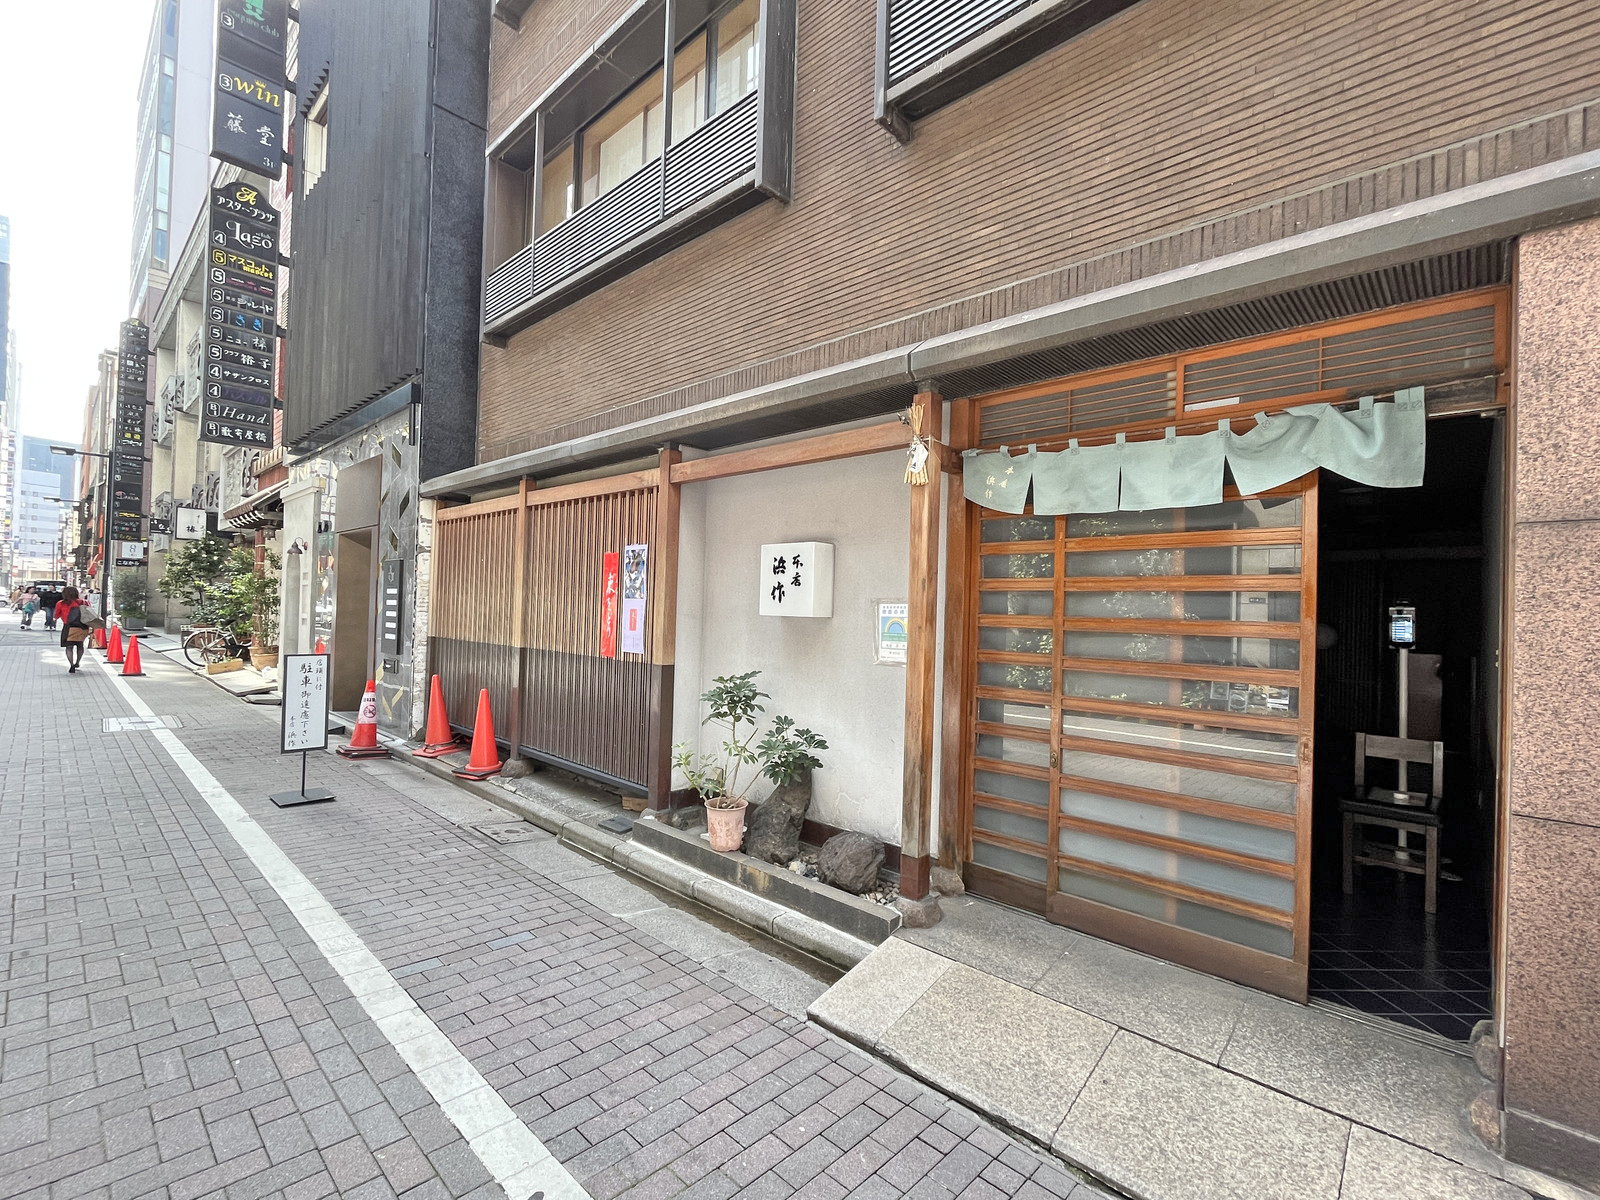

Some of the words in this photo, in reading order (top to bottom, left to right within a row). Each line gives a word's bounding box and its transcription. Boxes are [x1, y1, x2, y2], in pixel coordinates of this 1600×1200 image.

[234, 77, 280, 107] win
[217, 195, 275, 222] アスタープラザ
[228, 253, 270, 272] マスコット
[223, 370, 269, 386] サザンクロス
[771, 556, 787, 603] 浜作
